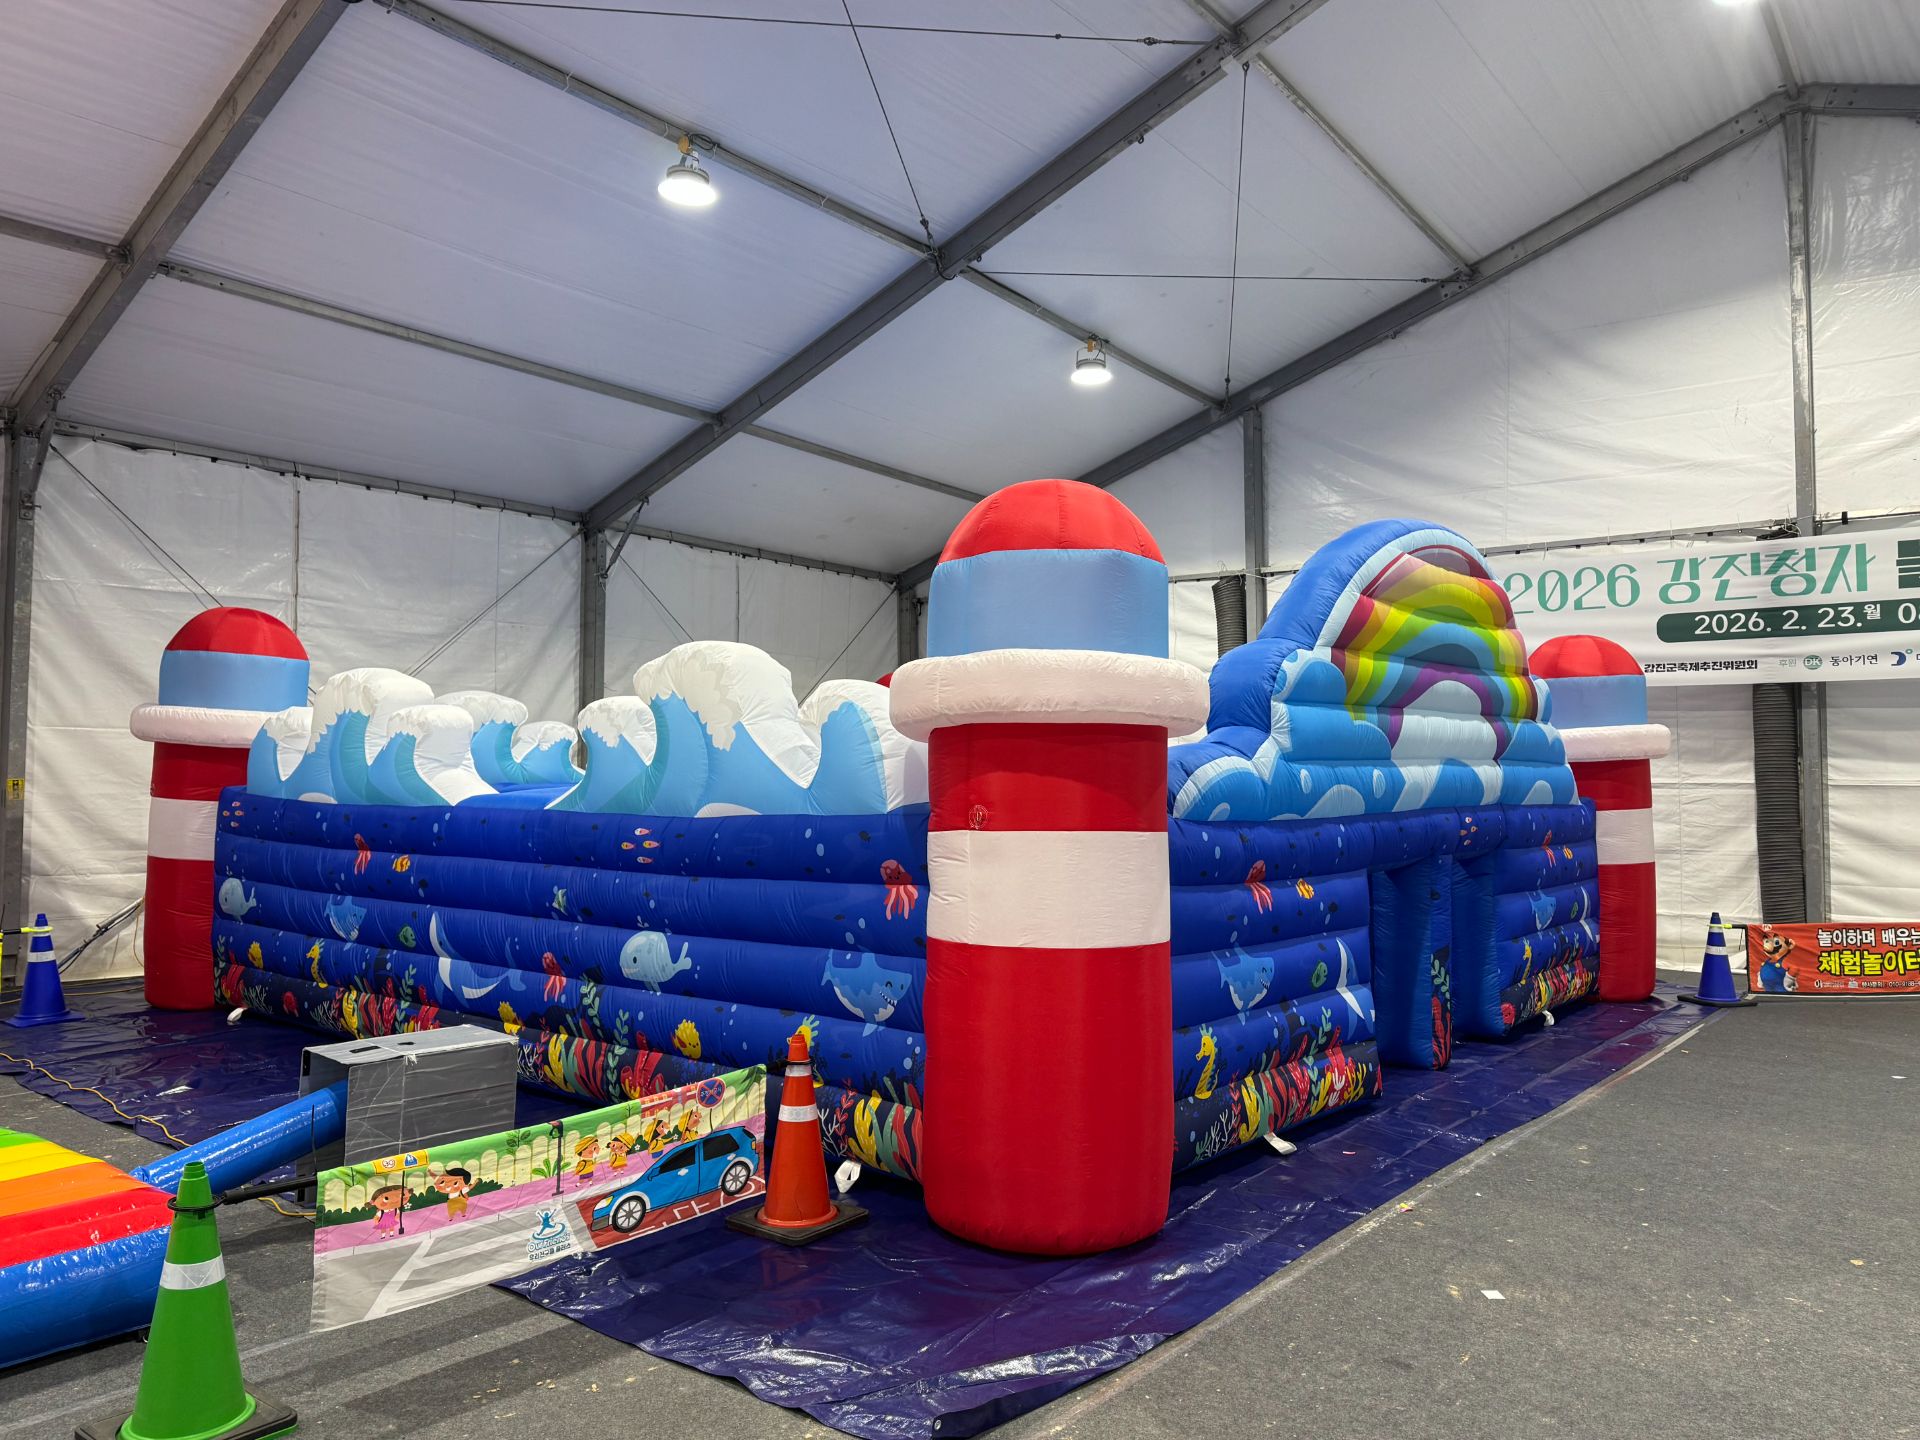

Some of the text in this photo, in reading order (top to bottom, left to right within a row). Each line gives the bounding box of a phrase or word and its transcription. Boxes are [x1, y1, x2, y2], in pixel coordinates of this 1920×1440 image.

[1503, 563, 1641, 615] 2026
[1657, 543, 1877, 605] 강진청자
[1694, 611, 1772, 635] 2026.
[1782, 609, 1807, 631] 2.
[1643, 659, 1759, 674] 강진군축제추진위원회
[1829, 653, 1879, 667] 동아기연
[1818, 928, 1876, 947] 놀이하며
